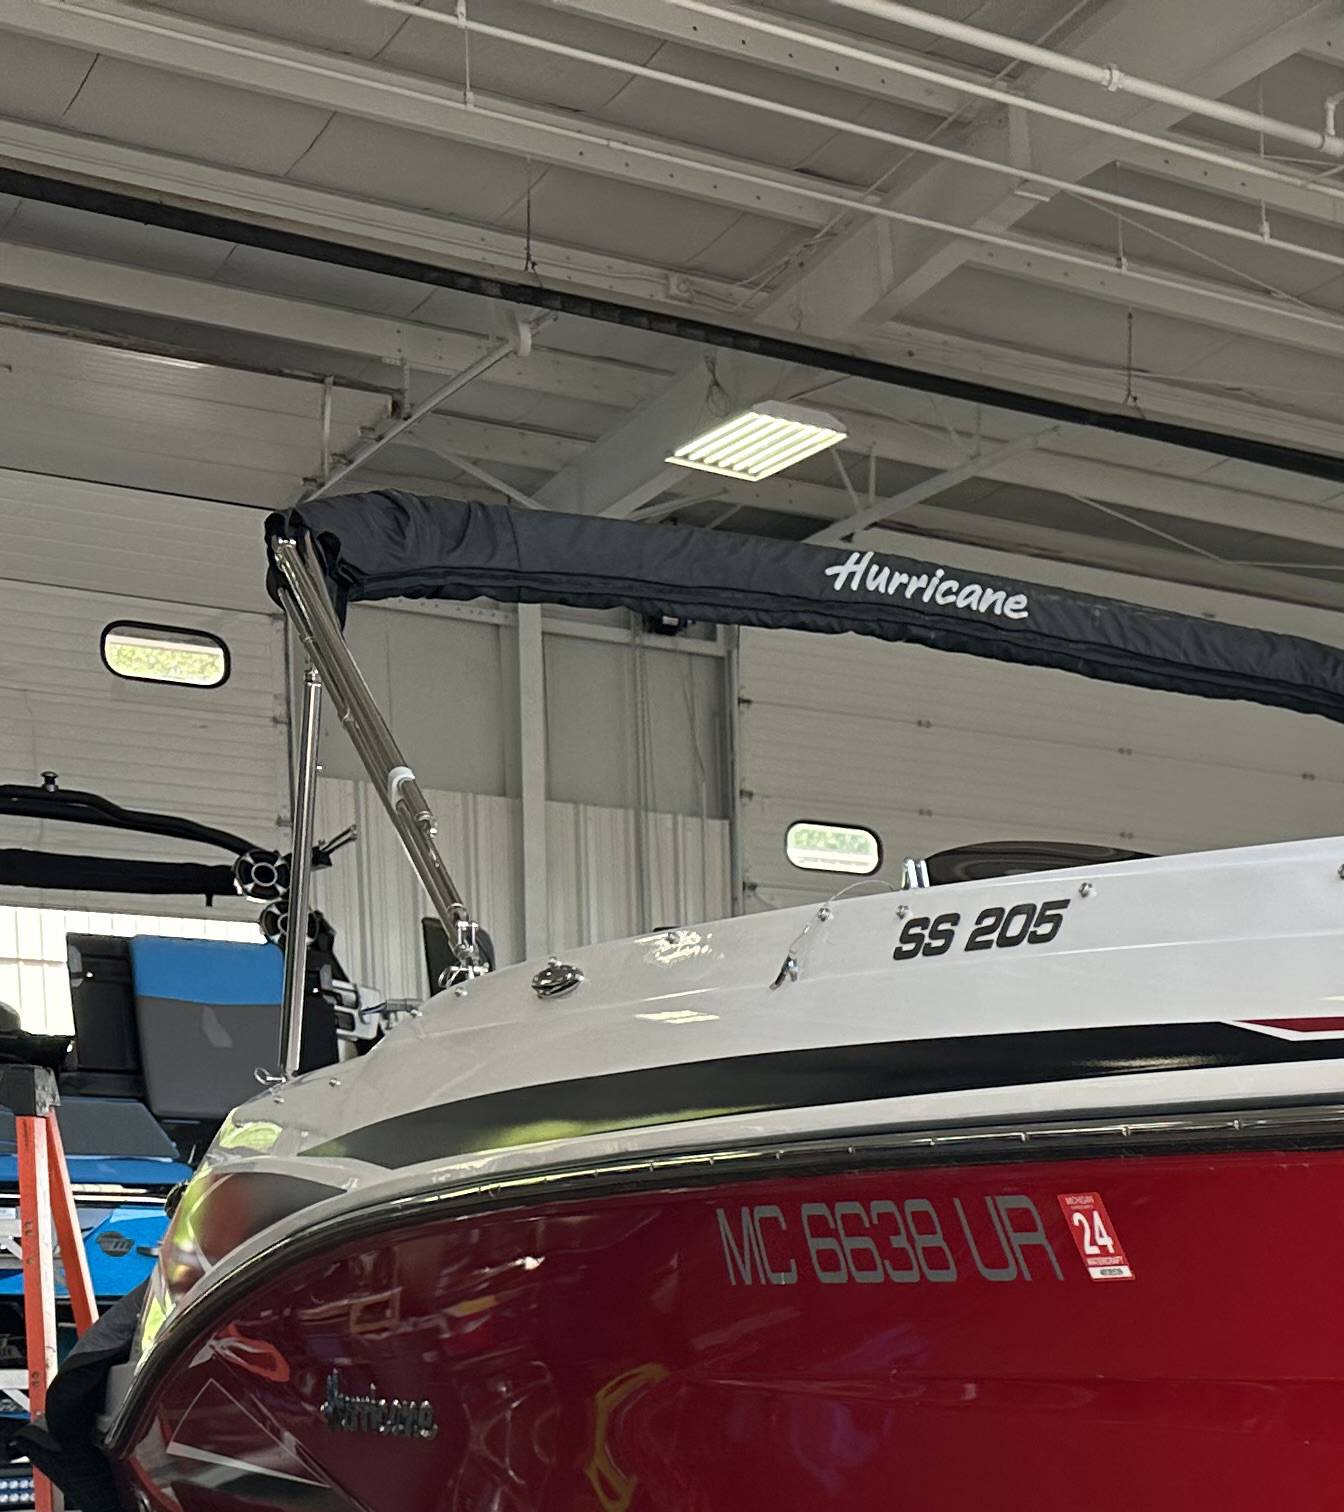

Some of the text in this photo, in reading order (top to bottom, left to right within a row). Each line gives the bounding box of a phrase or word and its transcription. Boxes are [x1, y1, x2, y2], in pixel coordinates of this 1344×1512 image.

[825, 551, 1029, 620] Hurricane
[893, 898, 1071, 960] SS 205
[716, 1195, 1064, 1286] MC 6638 UR
[1072, 1210, 1115, 1255] 24
